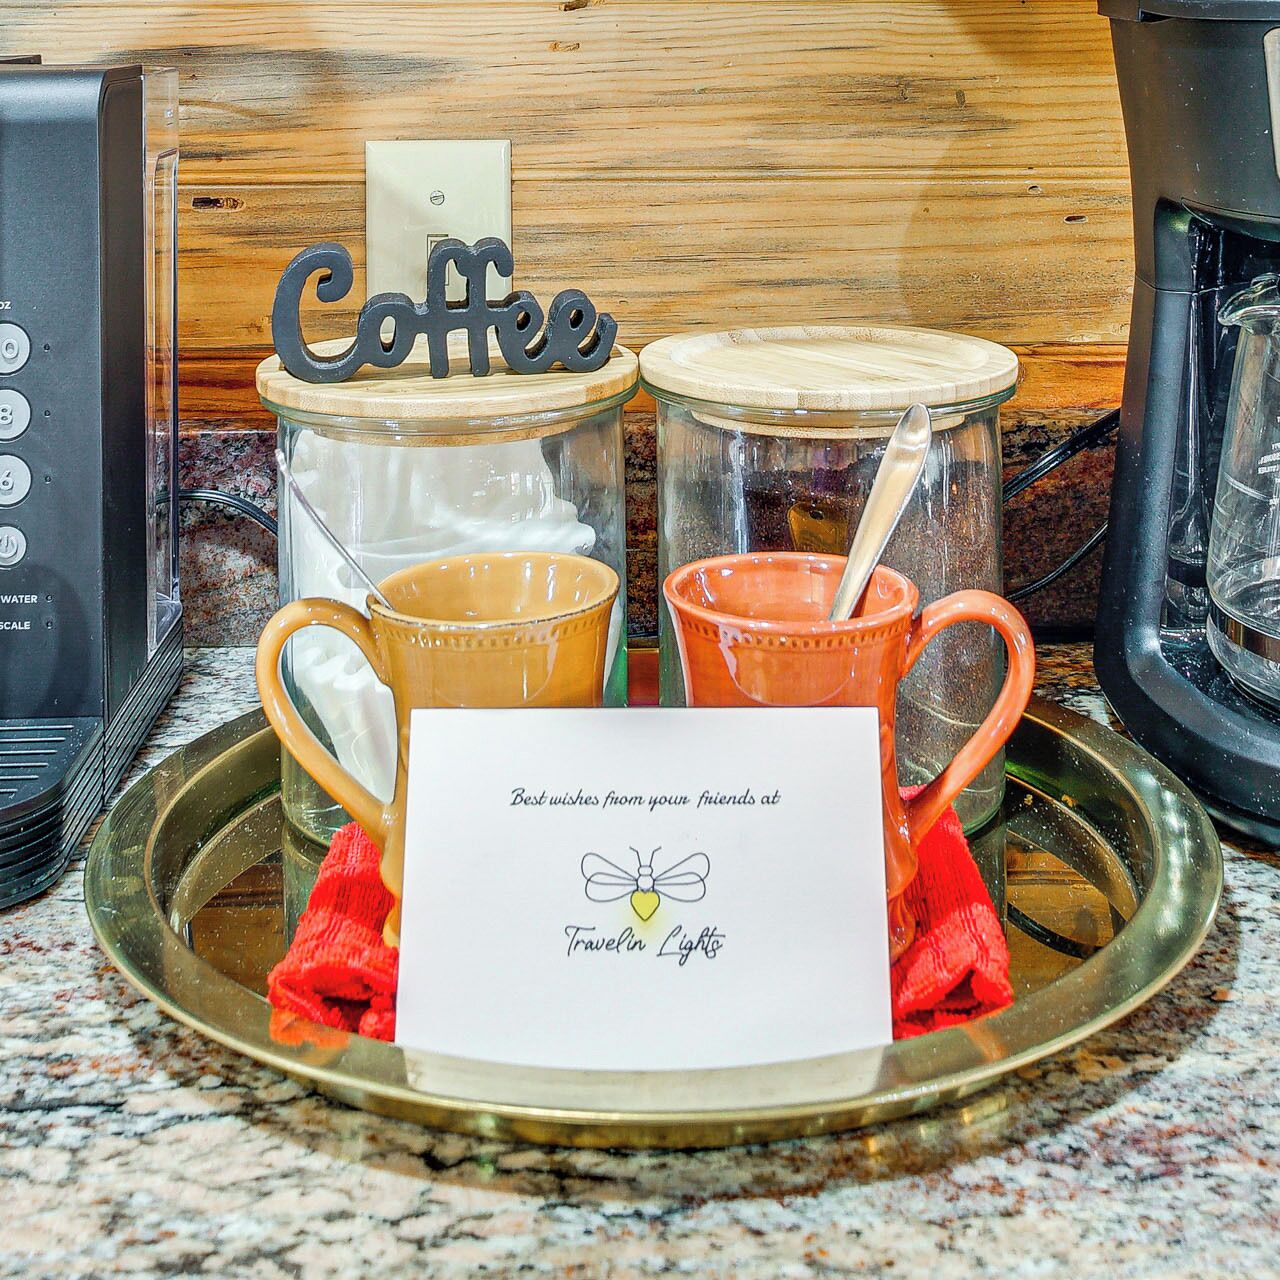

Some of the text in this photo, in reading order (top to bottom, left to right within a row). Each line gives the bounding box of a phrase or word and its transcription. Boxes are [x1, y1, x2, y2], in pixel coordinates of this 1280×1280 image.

[272, 237, 619, 383] Coffee
[0, 470, 15, 491] 6
[0, 595, 38, 604] WATER
[511, 787, 781, 812] Best wishes from your friends at
[565, 924, 726, 967] Travelin Lights
